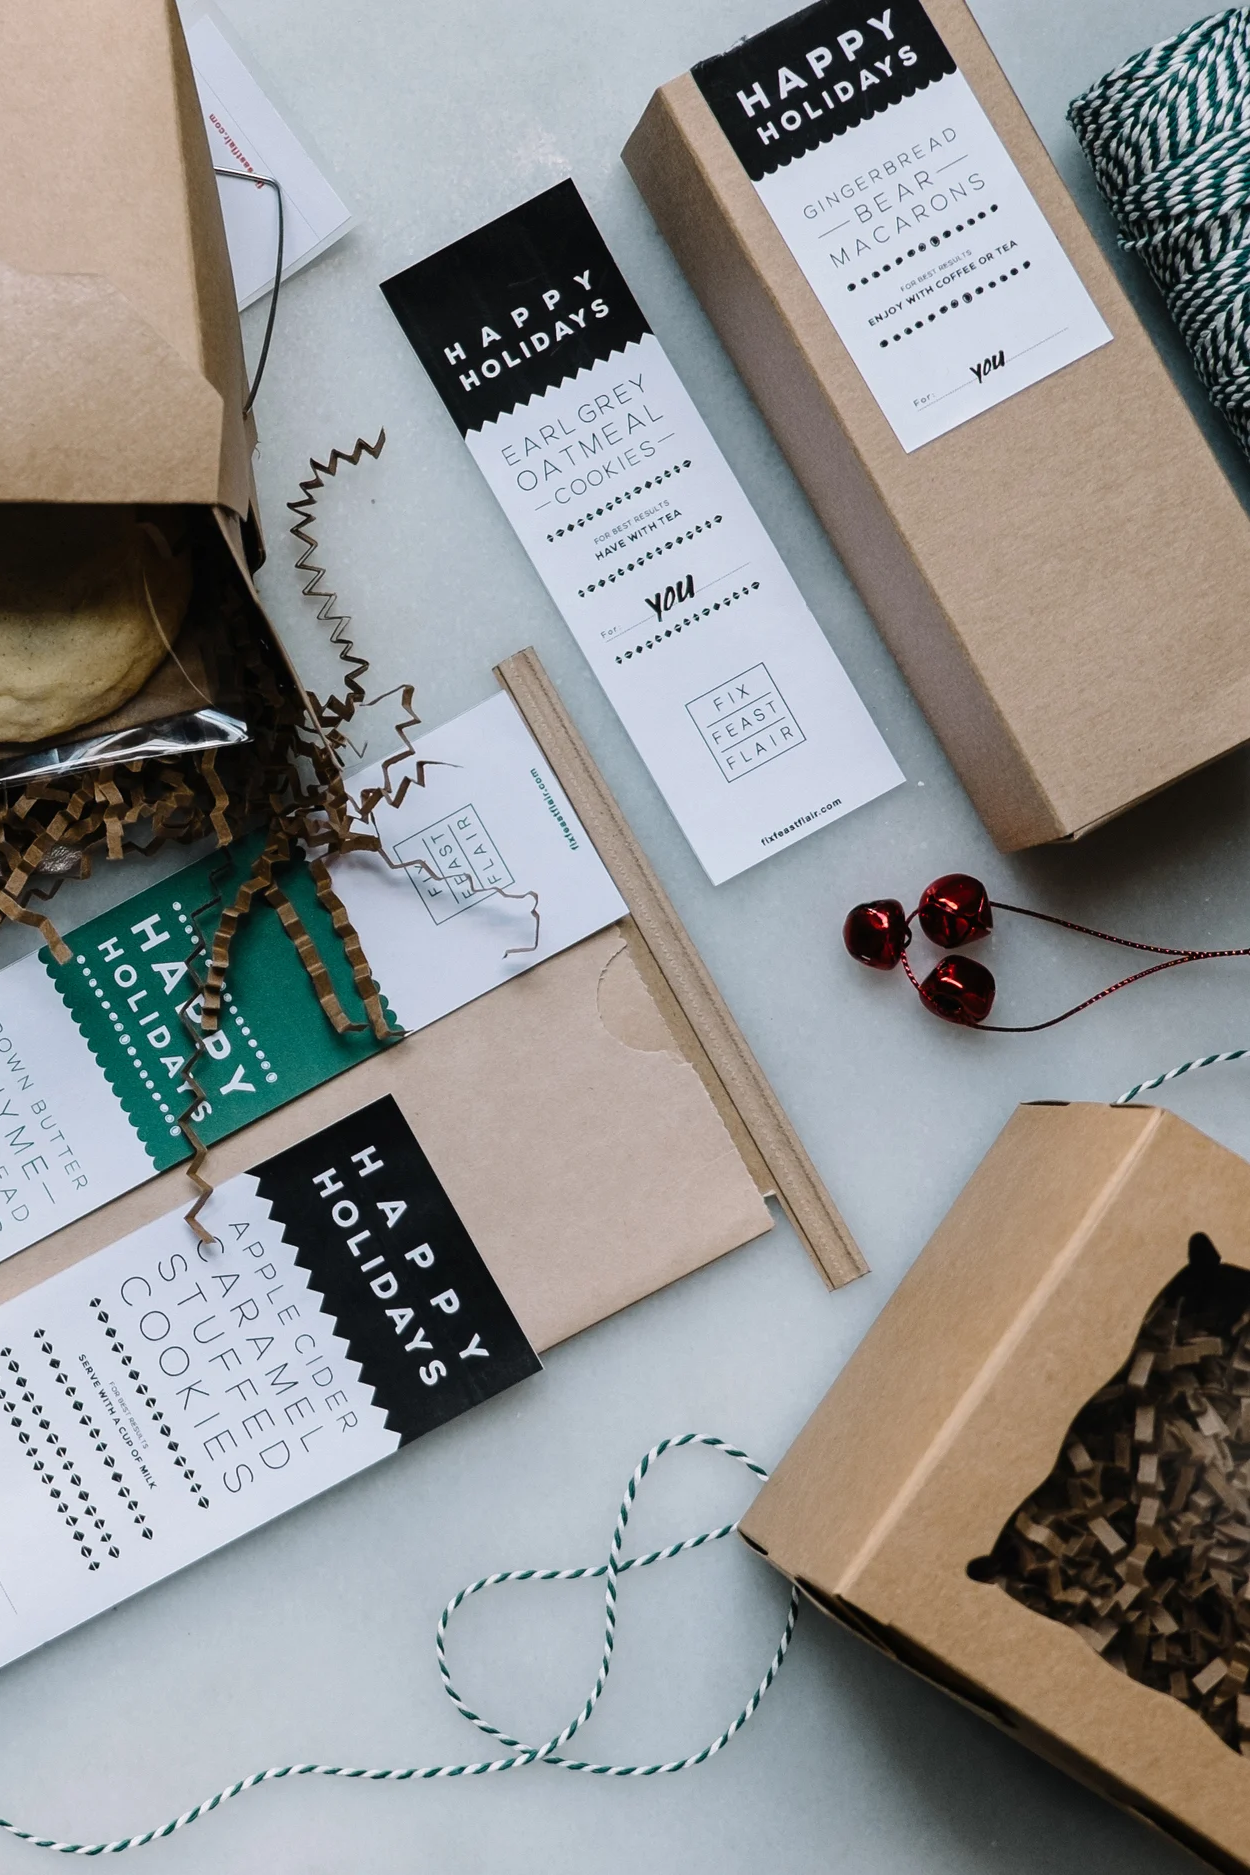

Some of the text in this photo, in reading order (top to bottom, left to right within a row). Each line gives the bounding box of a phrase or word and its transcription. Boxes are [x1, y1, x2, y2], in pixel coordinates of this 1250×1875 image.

[736, 8, 897, 118] HAPPY
[756, 44, 918, 146] HOLIDAYS
[802, 127, 957, 220] GINGERBREAD
[854, 169, 935, 224] BEAR
[829, 172, 986, 269] MACARONS
[868, 240, 1018, 327] ENJOY WITH COFFEE OR TEA
[900, 249, 972, 292] FOR BEST RESULTS
[444, 269, 593, 366] HAPPY
[458, 298, 610, 392] HOLIDAYS
[500, 373, 645, 467] EARL GREY
[516, 404, 664, 492] OATMEAL
[554, 440, 656, 505] COOKIES
[593, 499, 670, 545] FOR BEST RESULTS
[594, 509, 683, 561] HAVE WITH TEA
[711, 700, 780, 745] FEAST
[713, 683, 750, 712] FIX
[726, 725, 795, 771] FLAIR
[457, 816, 502, 884] FLAIR
[530, 768, 579, 850] fixfeastflair.com
[760, 797, 842, 847] fixfeastflair.com
[431, 833, 477, 899] FEAST
[30, 1100, 89, 1191] BUTTER
[312, 1166, 448, 1387] HOLIDAYS
[350, 1145, 490, 1363] HAPPY
[157, 1253, 292, 1471] STUFFED
[196, 1235, 324, 1454] CARAMEL
[228, 1221, 359, 1434] APPLE CIDER
[79, 1354, 158, 1490] SERVE WITH A CUP OF MILK
[109, 1381, 149, 1450] FOR BEST RESULTS
[120, 1276, 254, 1494] COOKIES
